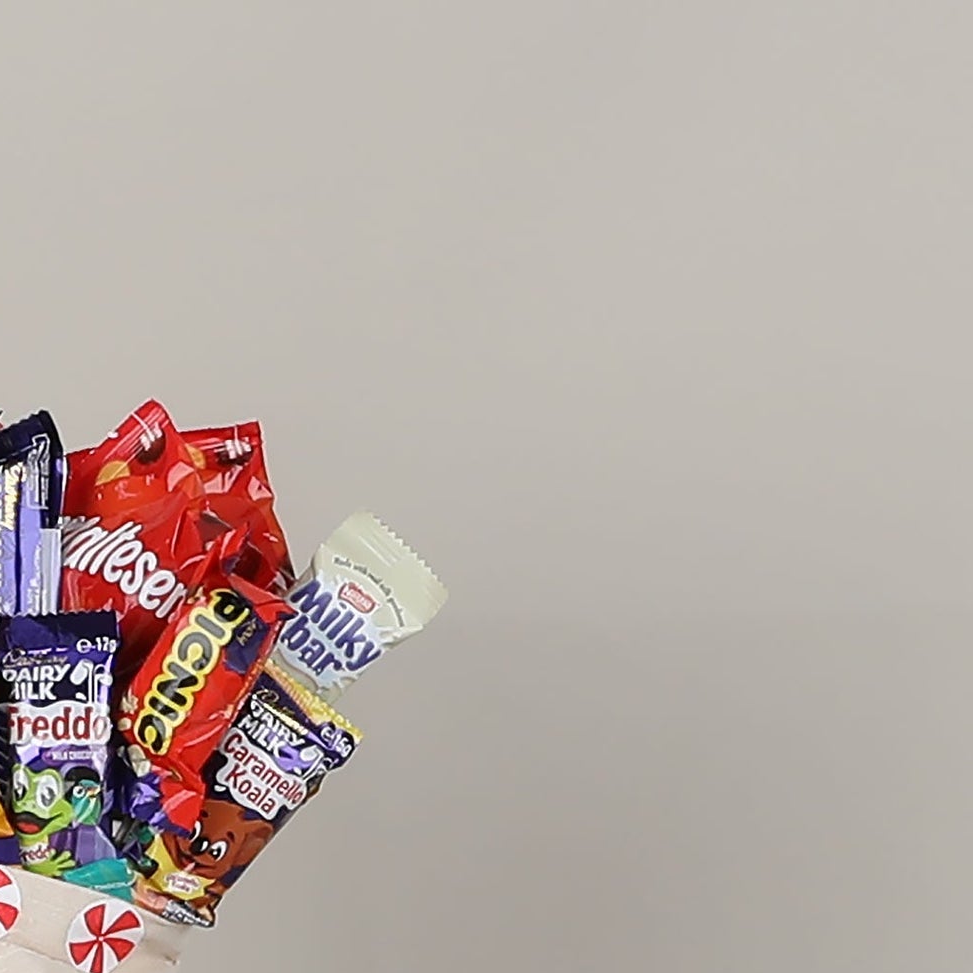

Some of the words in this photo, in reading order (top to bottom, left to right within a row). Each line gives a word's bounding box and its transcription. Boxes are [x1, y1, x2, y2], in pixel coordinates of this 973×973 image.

[280, 614, 344, 677] bar
[290, 579, 382, 672] Milky
[2, 663, 72, 683] DAIRY
[135, 589, 249, 755] PICNIC
[237, 714, 287, 759] MILK
[223, 732, 305, 806] Caramello
[224, 763, 277, 814] Koala
